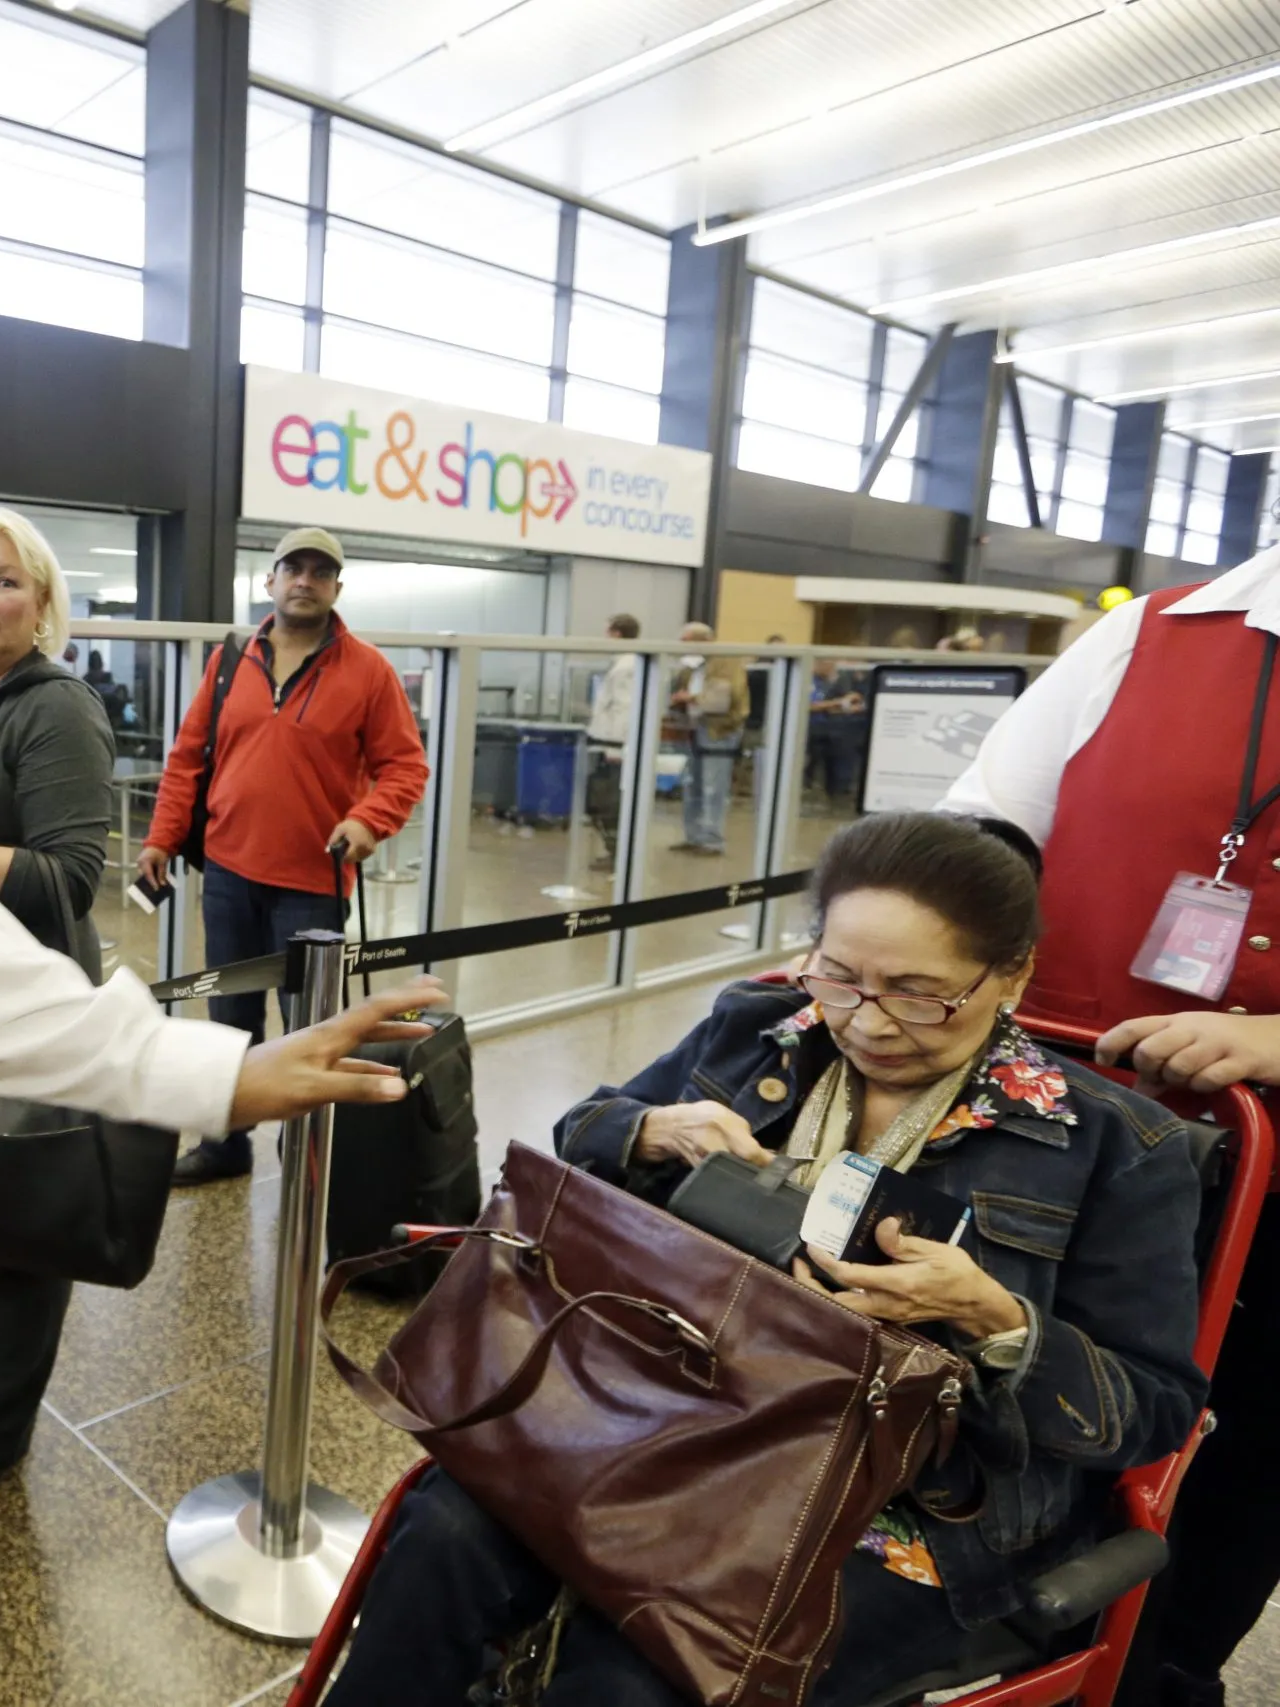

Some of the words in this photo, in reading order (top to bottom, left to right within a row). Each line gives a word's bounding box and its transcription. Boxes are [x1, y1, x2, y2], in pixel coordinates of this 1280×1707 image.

[271, 409, 369, 495] eat
[375, 411, 429, 502] &
[435, 421, 557, 538] shop
[587, 456, 606, 491] in
[611, 470, 669, 511] every
[583, 501, 695, 540] concourse
[362, 951, 376, 962] Port
[384, 945, 407, 958] Seattle
[173, 985, 193, 998] Port
